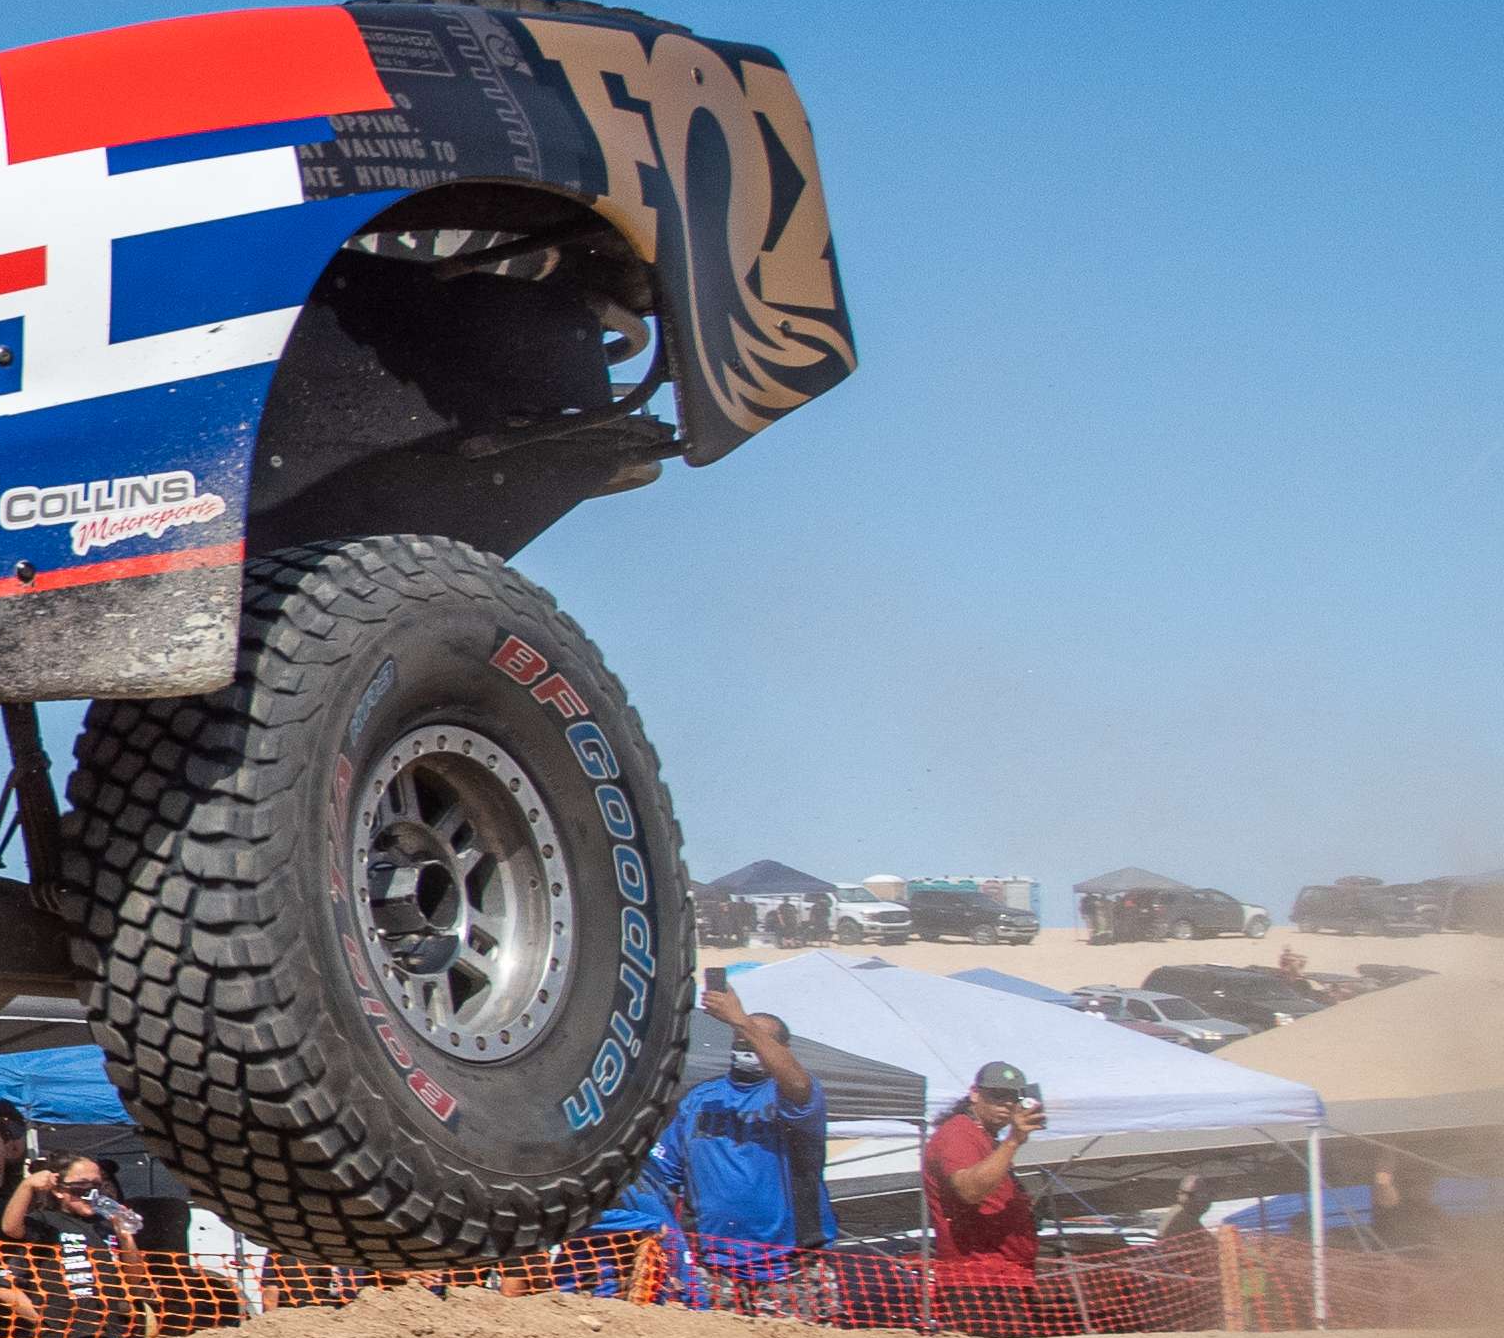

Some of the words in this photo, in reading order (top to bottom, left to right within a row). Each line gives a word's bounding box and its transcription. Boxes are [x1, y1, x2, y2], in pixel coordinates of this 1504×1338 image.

[337, 138, 426, 160] VALVING
[431, 140, 457, 163] TO
[5, 476, 190, 524] COLLINS
[76, 500, 218, 547] Motorsports
[488, 634, 657, 1132] BFGoodrich
